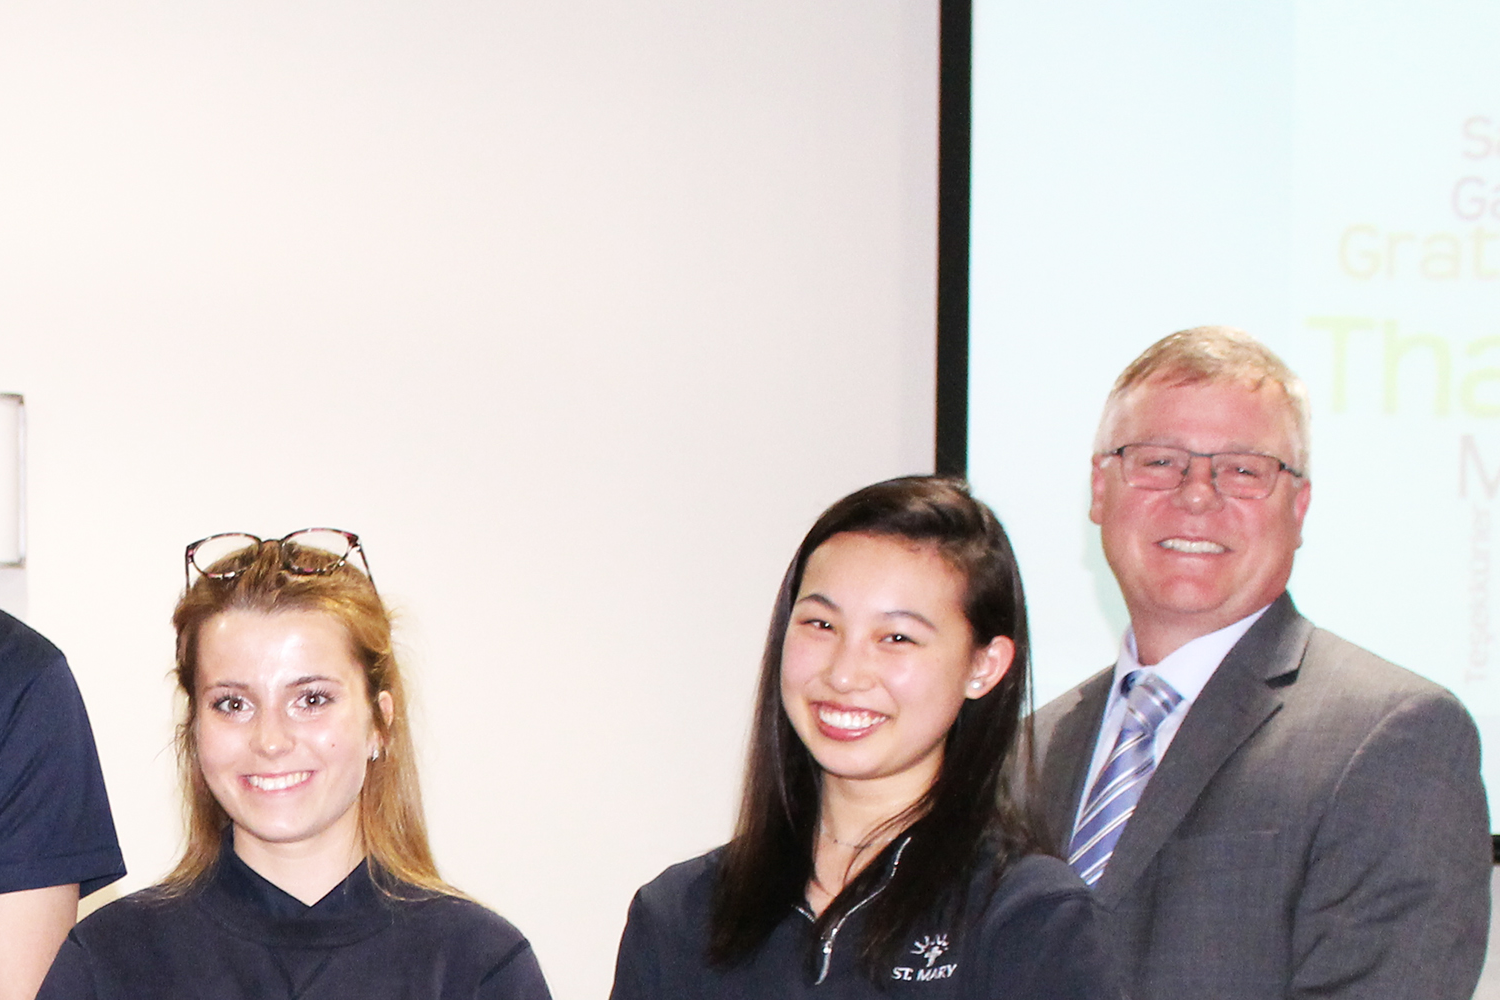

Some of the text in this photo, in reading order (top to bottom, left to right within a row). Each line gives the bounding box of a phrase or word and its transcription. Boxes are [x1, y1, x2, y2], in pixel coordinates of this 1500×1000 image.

[1461, 114, 1500, 162] S
[1305, 315, 1500, 419] Tha
[891, 963, 958, 982] ST. MARY
